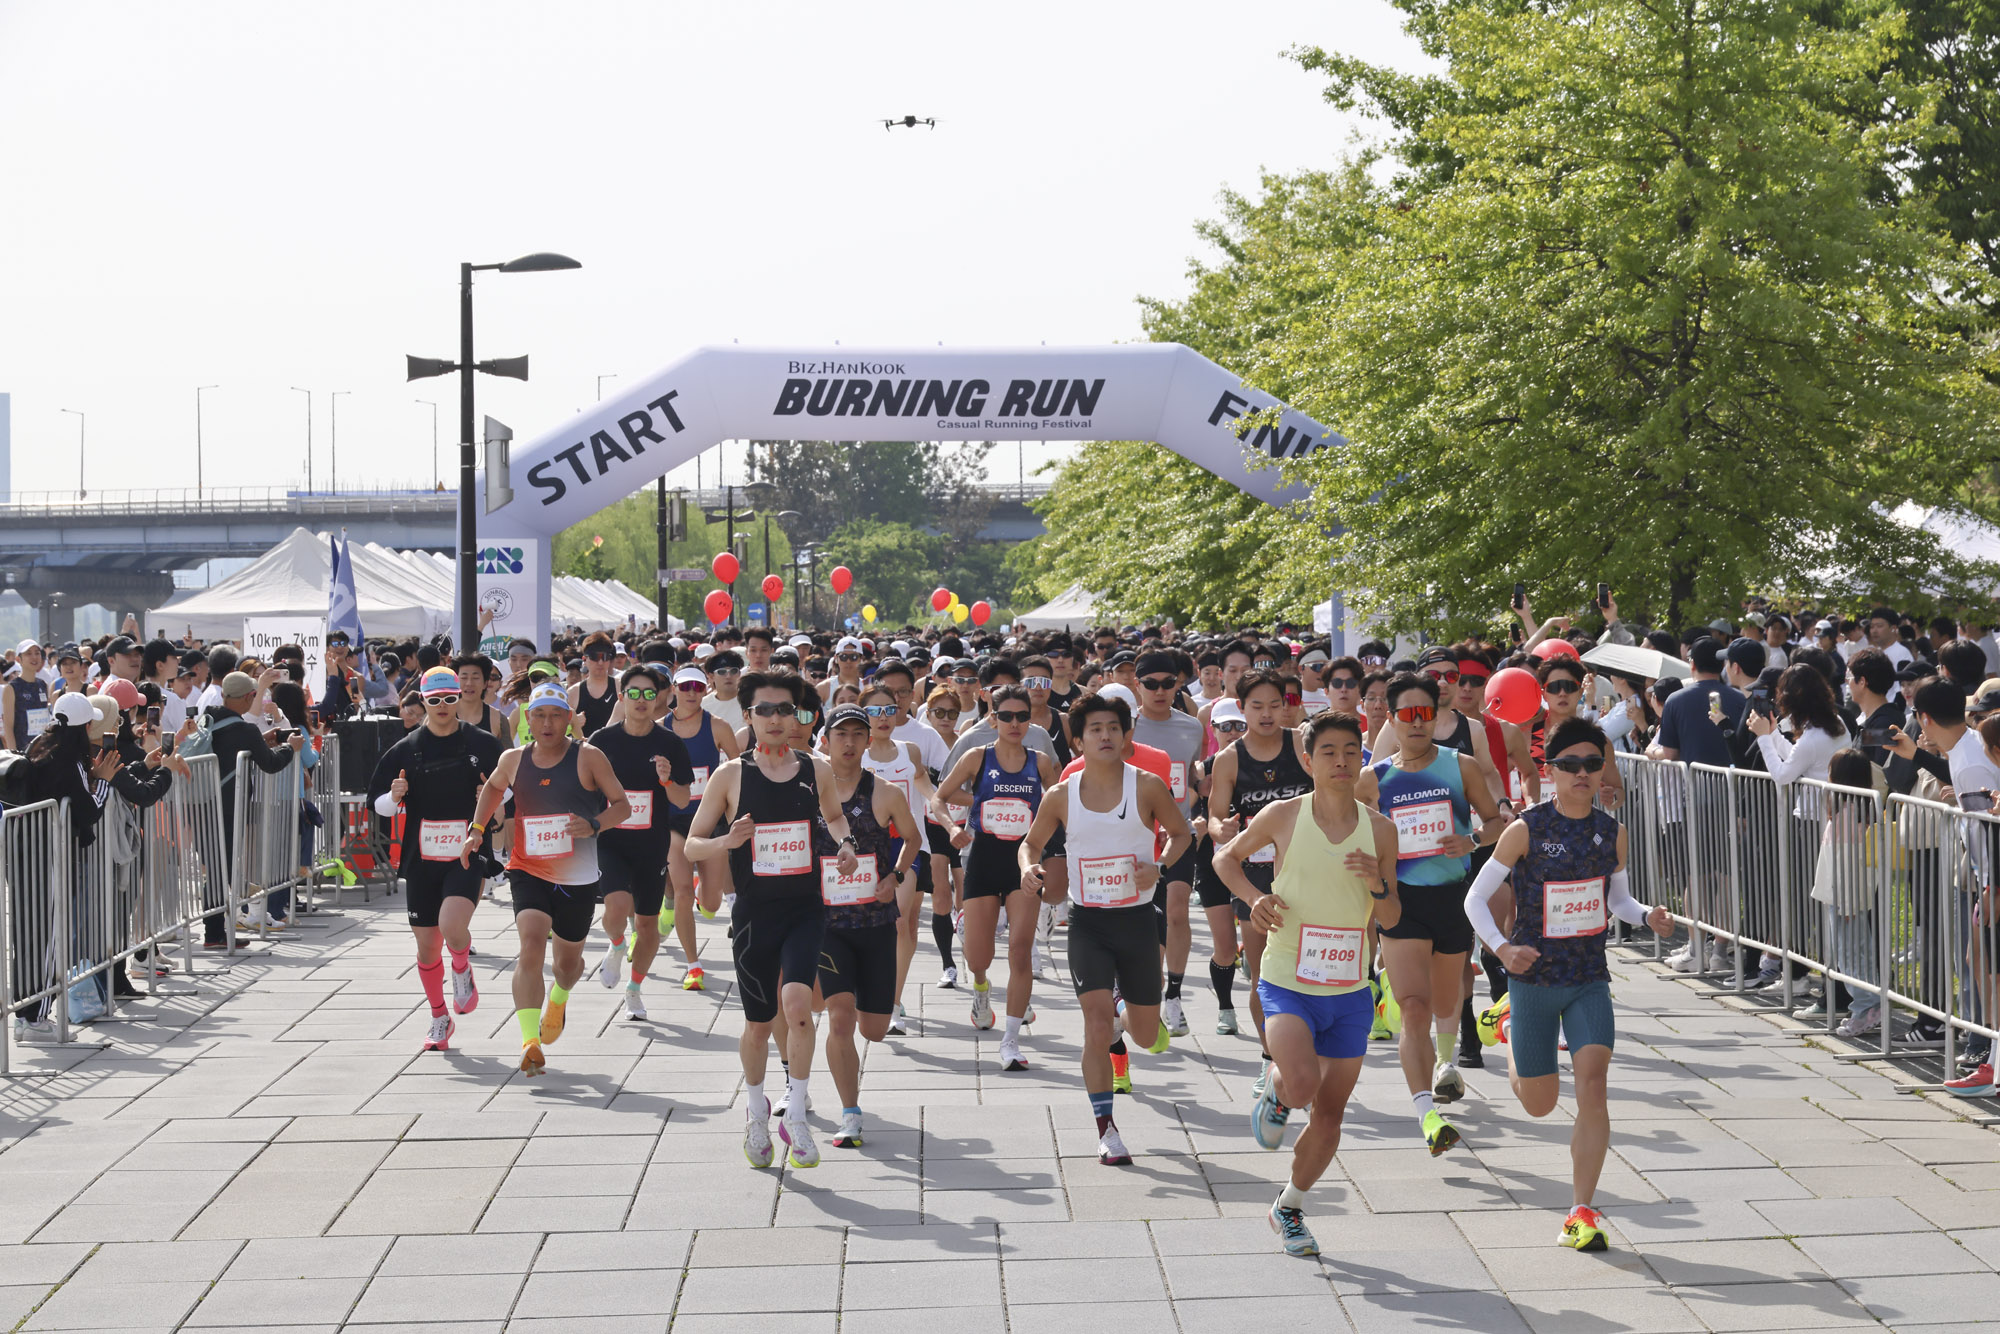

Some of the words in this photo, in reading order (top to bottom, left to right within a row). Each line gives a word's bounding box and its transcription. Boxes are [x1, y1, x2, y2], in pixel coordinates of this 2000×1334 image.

[773, 378, 990, 417] BURNING
[998, 378, 1106, 417] RUN
[937, 420, 981, 430] Casual
[985, 420, 1039, 431] Running
[1042, 419, 1092, 430] Festival
[1208, 389, 1328, 459] FINI
[527, 389, 686, 506] START
[250, 633, 282, 648] 10km
[293, 633, 319, 648] 7km
[993, 784, 1033, 793] DESCENTE
[1392, 787, 1450, 804] SALOMON
[995, 812, 1026, 823] 3434
[1411, 820, 1446, 836] 1910
[434, 834, 462, 844] 1274
[537, 830, 566, 842] 1841
[760, 844, 769, 852] M
[771, 839, 806, 853] 1460
[827, 876, 836, 884] M
[837, 872, 872, 885] 2448
[1087, 877, 1096, 885] M
[1098, 872, 1129, 886] 1901
[1552, 904, 1561, 913] M
[1563, 898, 1600, 914] 2449
[1306, 948, 1317, 957] M
[1320, 948, 1355, 962] 1809
